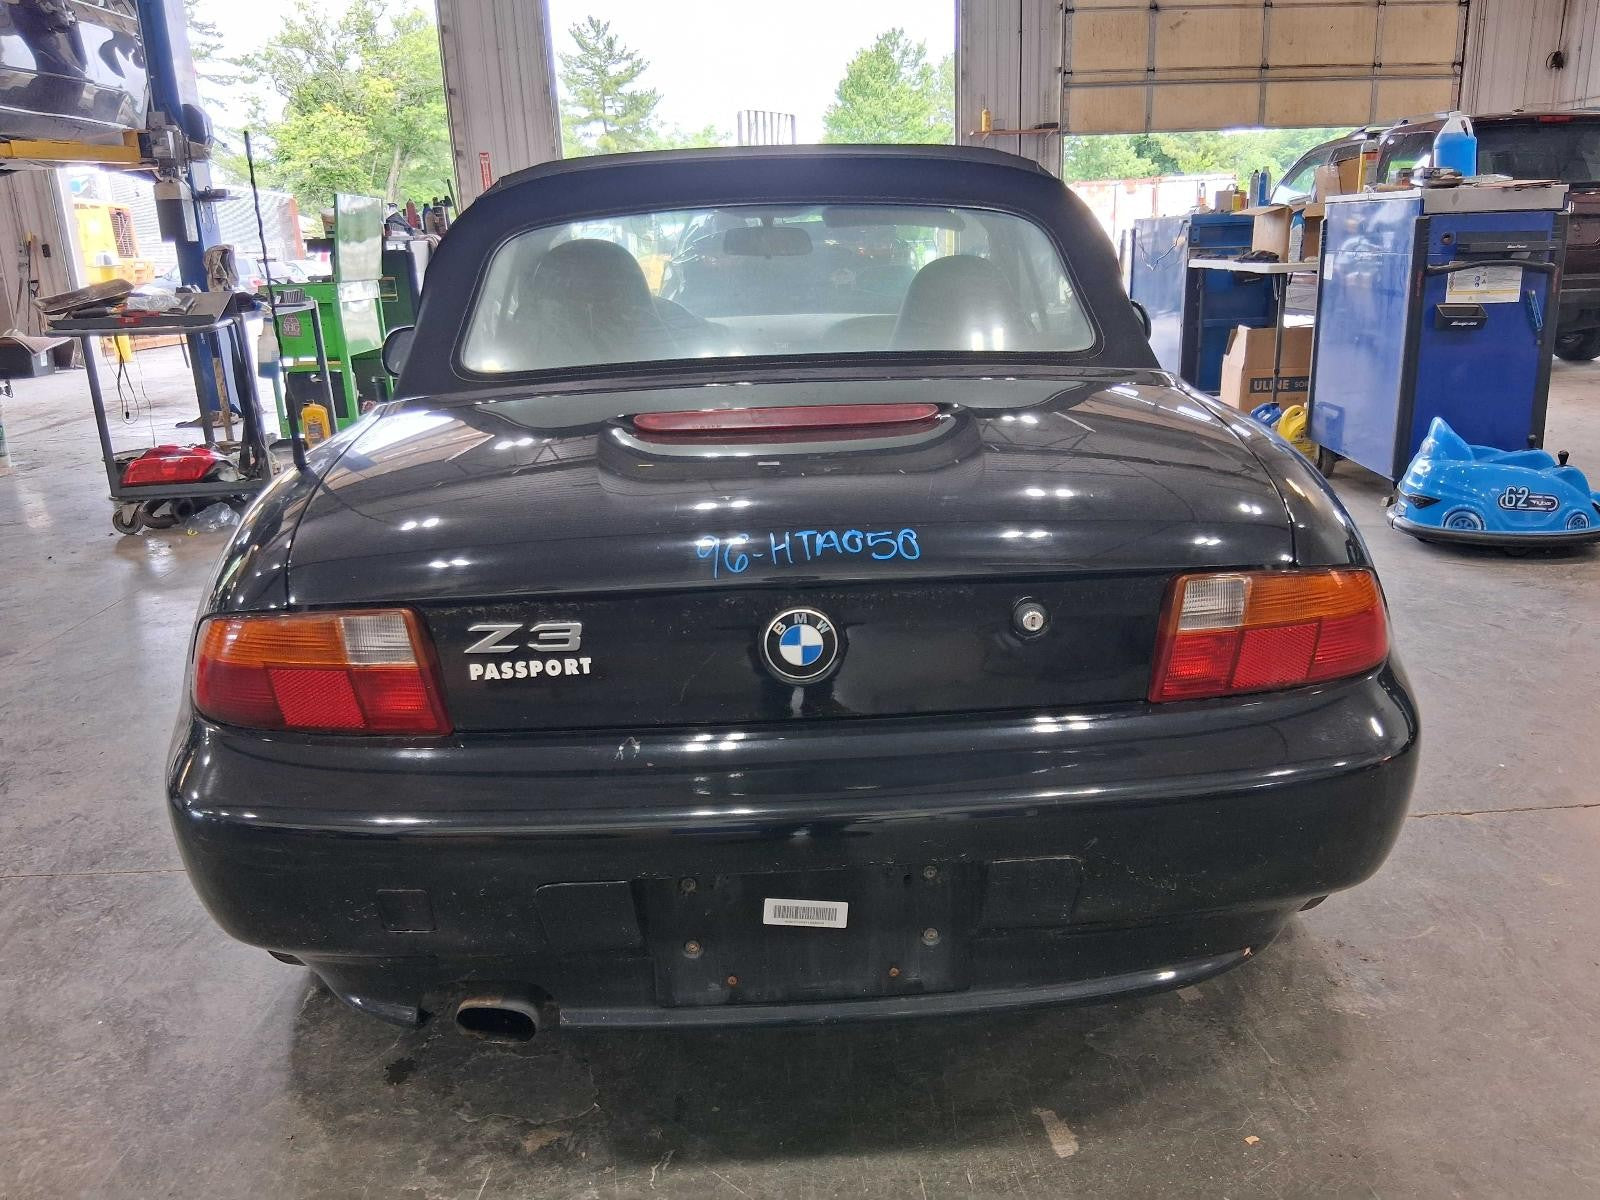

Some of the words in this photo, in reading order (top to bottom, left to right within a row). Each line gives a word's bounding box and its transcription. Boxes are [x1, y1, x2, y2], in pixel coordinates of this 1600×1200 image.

[1505, 486, 1529, 507] 62
[772, 612, 830, 636] BMW
[463, 622, 583, 654] Z3
[469, 657, 593, 681] PASSPORT
